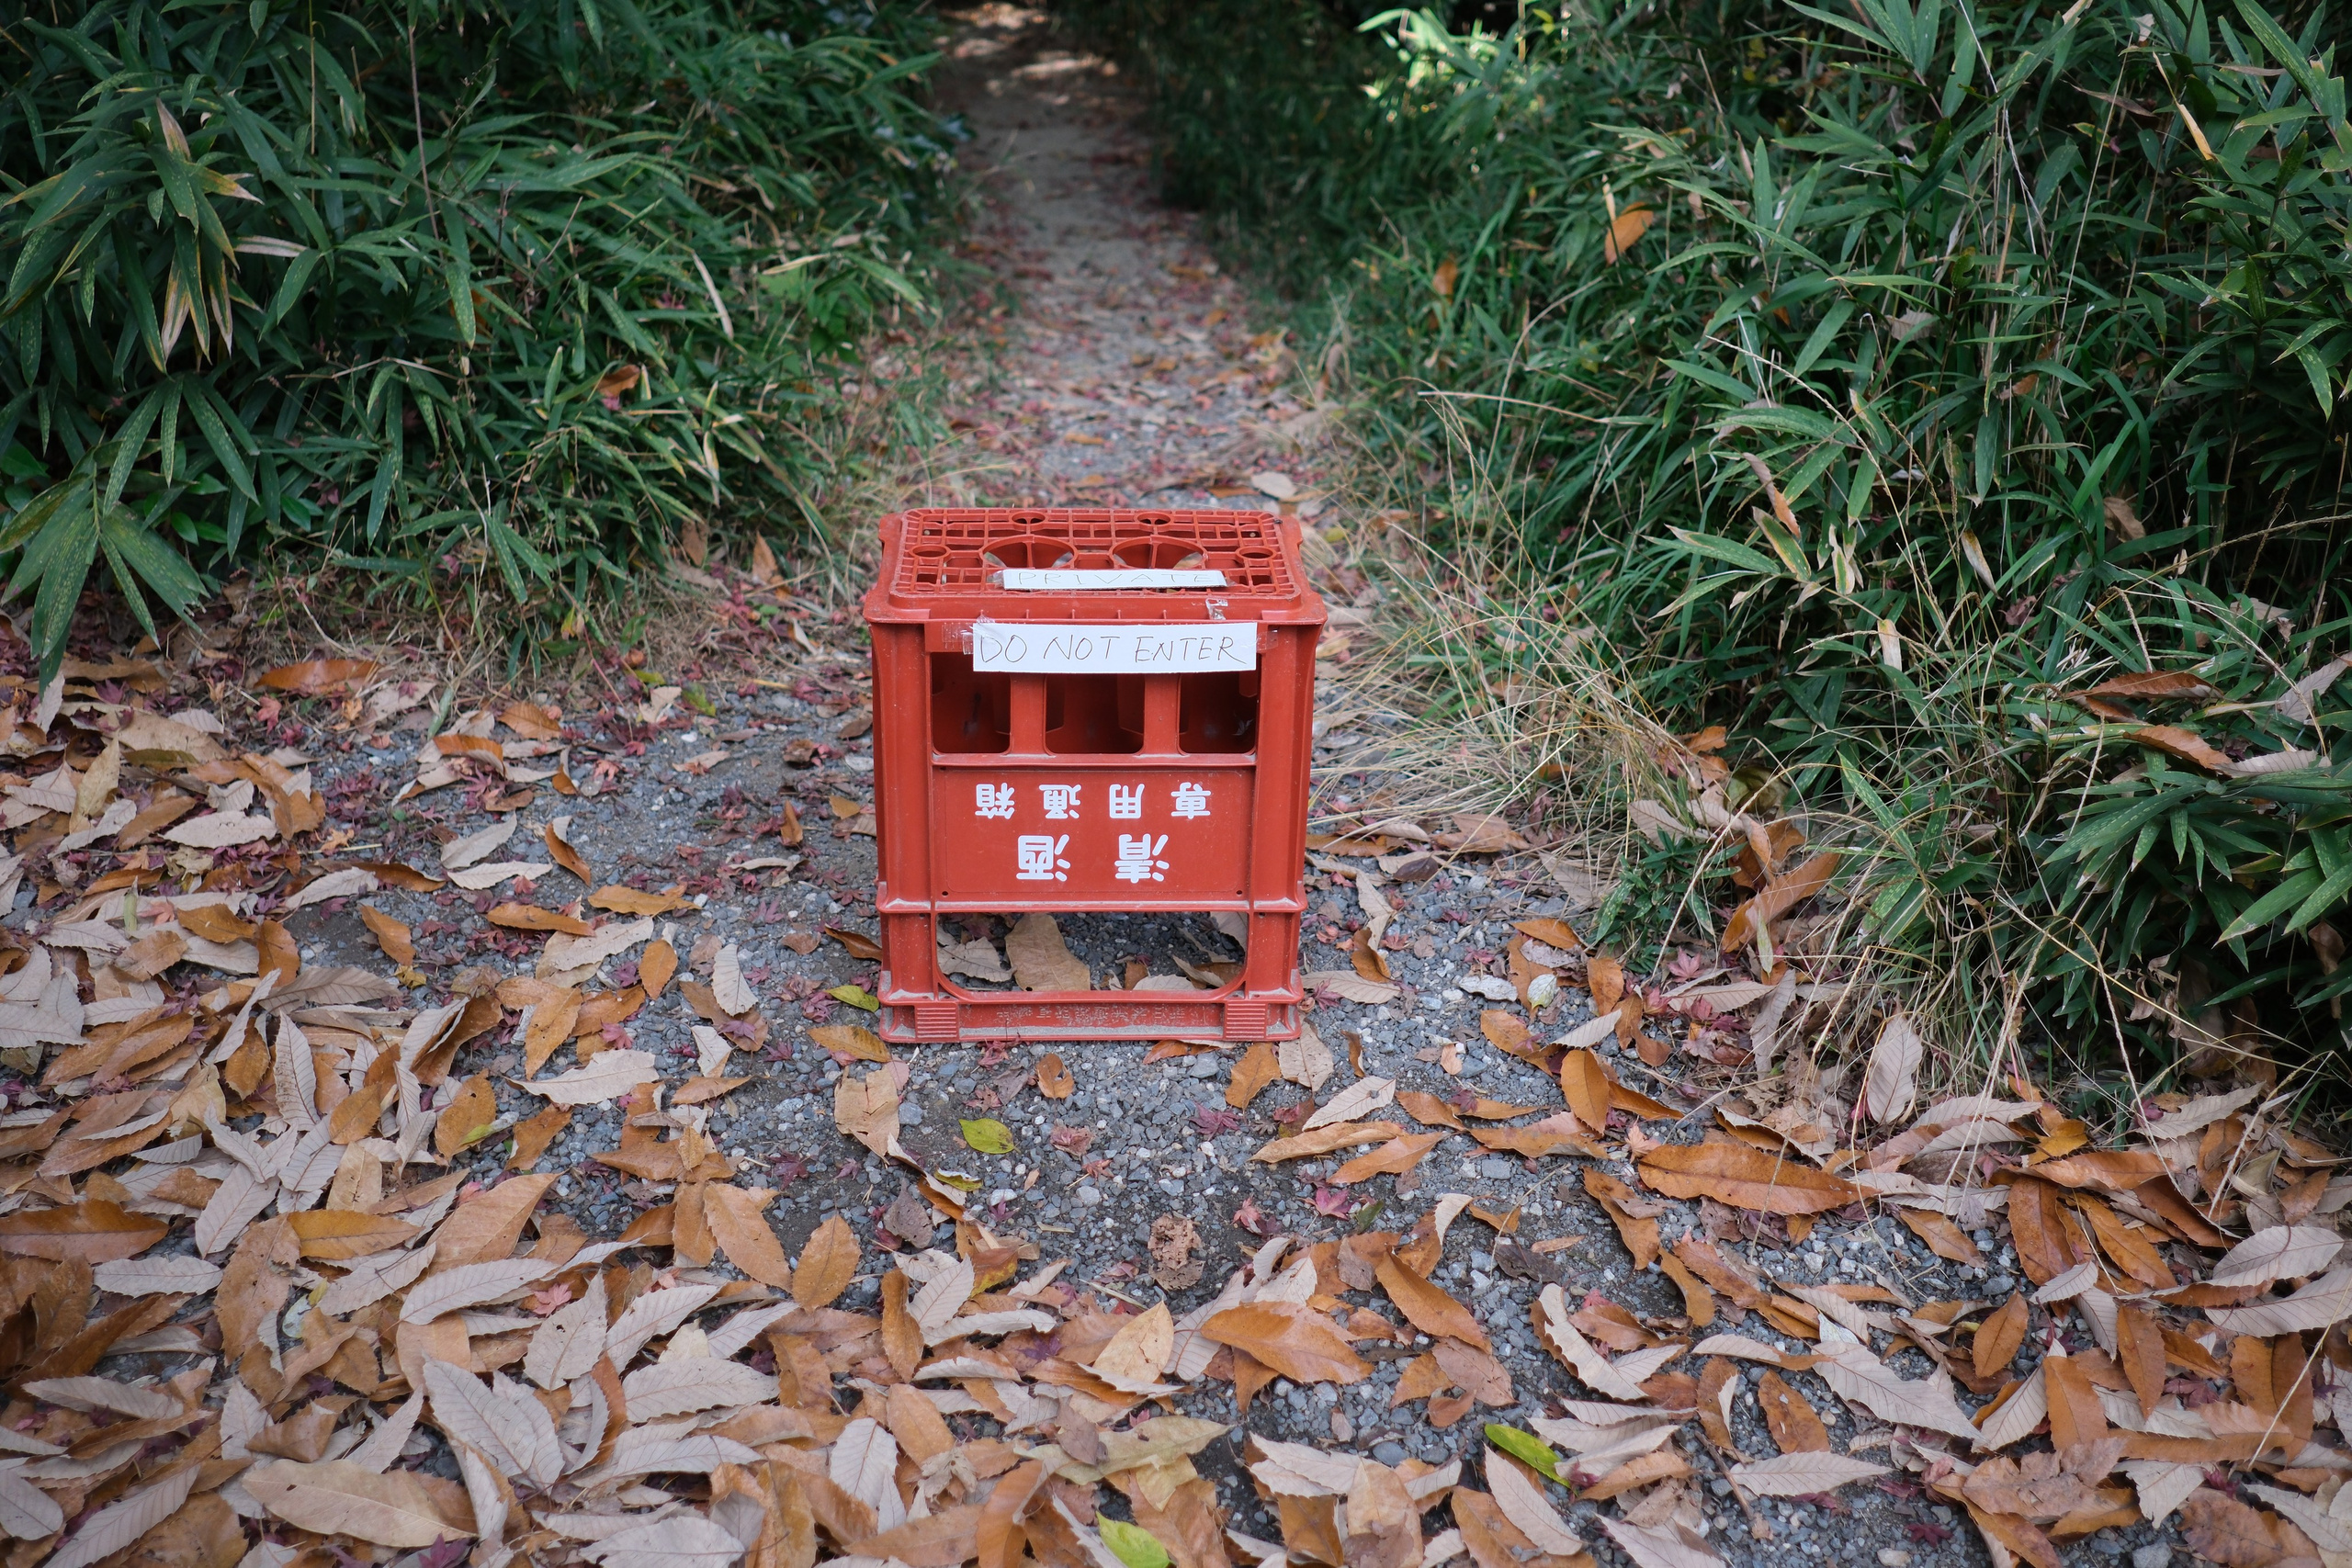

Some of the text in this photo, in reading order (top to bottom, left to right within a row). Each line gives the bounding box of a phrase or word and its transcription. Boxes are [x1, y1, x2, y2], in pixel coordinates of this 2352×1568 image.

[1018, 571, 1213, 585] PRIVATE
[979, 634, 1247, 664] DO NOT ENTER
[974, 782, 1212, 819] 専用通箱
[1015, 833, 1170, 884] 清酒
